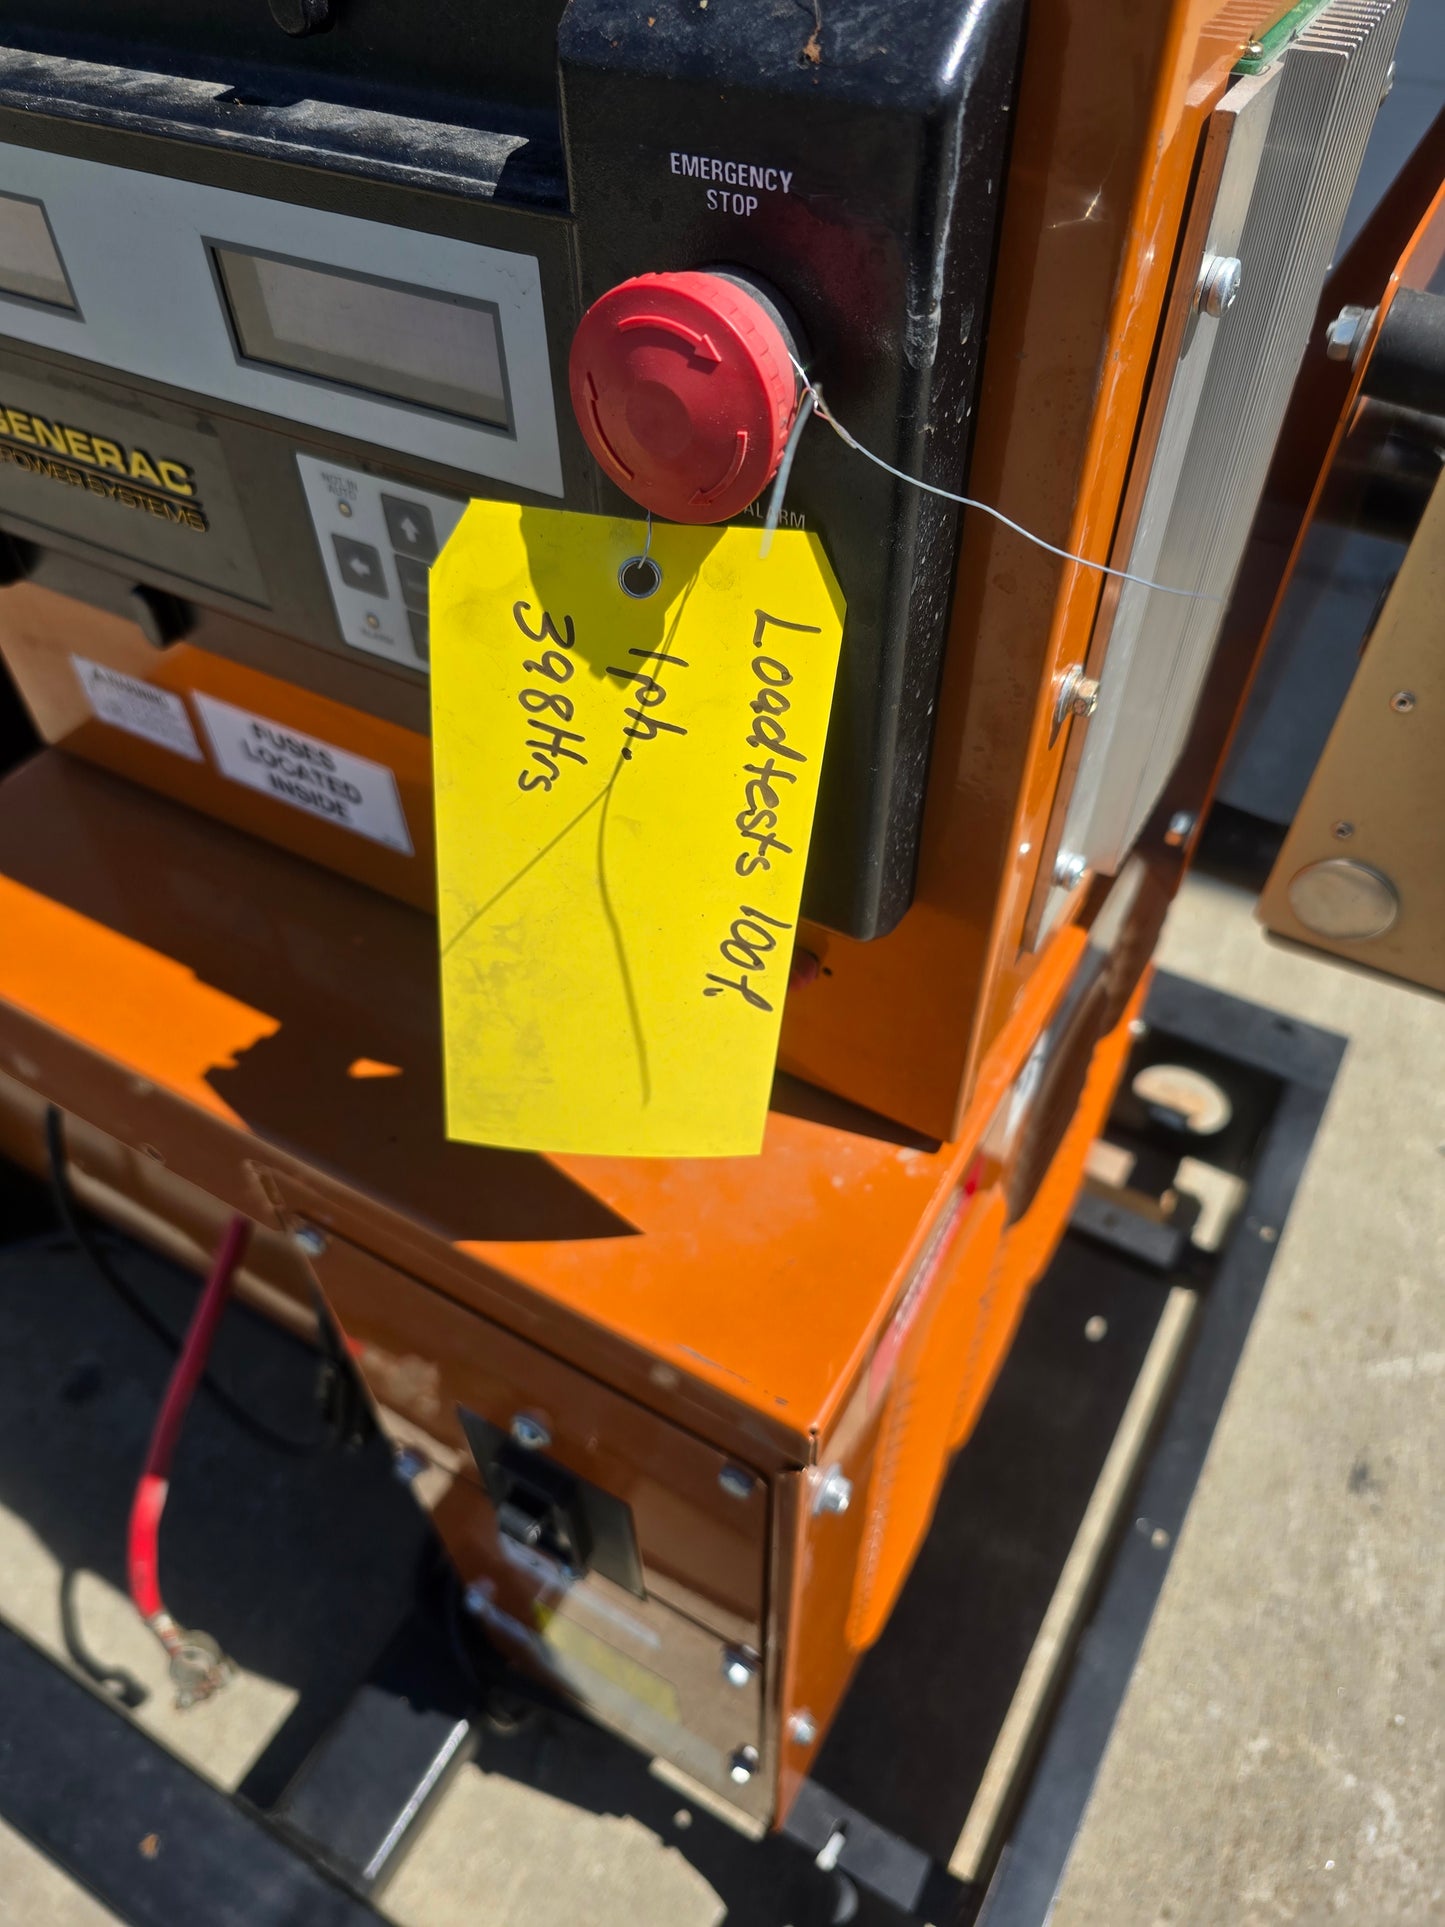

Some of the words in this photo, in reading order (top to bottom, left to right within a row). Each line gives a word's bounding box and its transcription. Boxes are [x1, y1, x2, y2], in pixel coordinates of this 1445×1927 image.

[670, 152, 793, 194] EMERGENCY
[706, 189, 758, 216] STOP
[87, 475, 206, 532] SYSTEMS
[241, 738, 363, 805] LOCATED
[252, 722, 336, 772] FUSES
[268, 772, 352, 823] INSIDE
